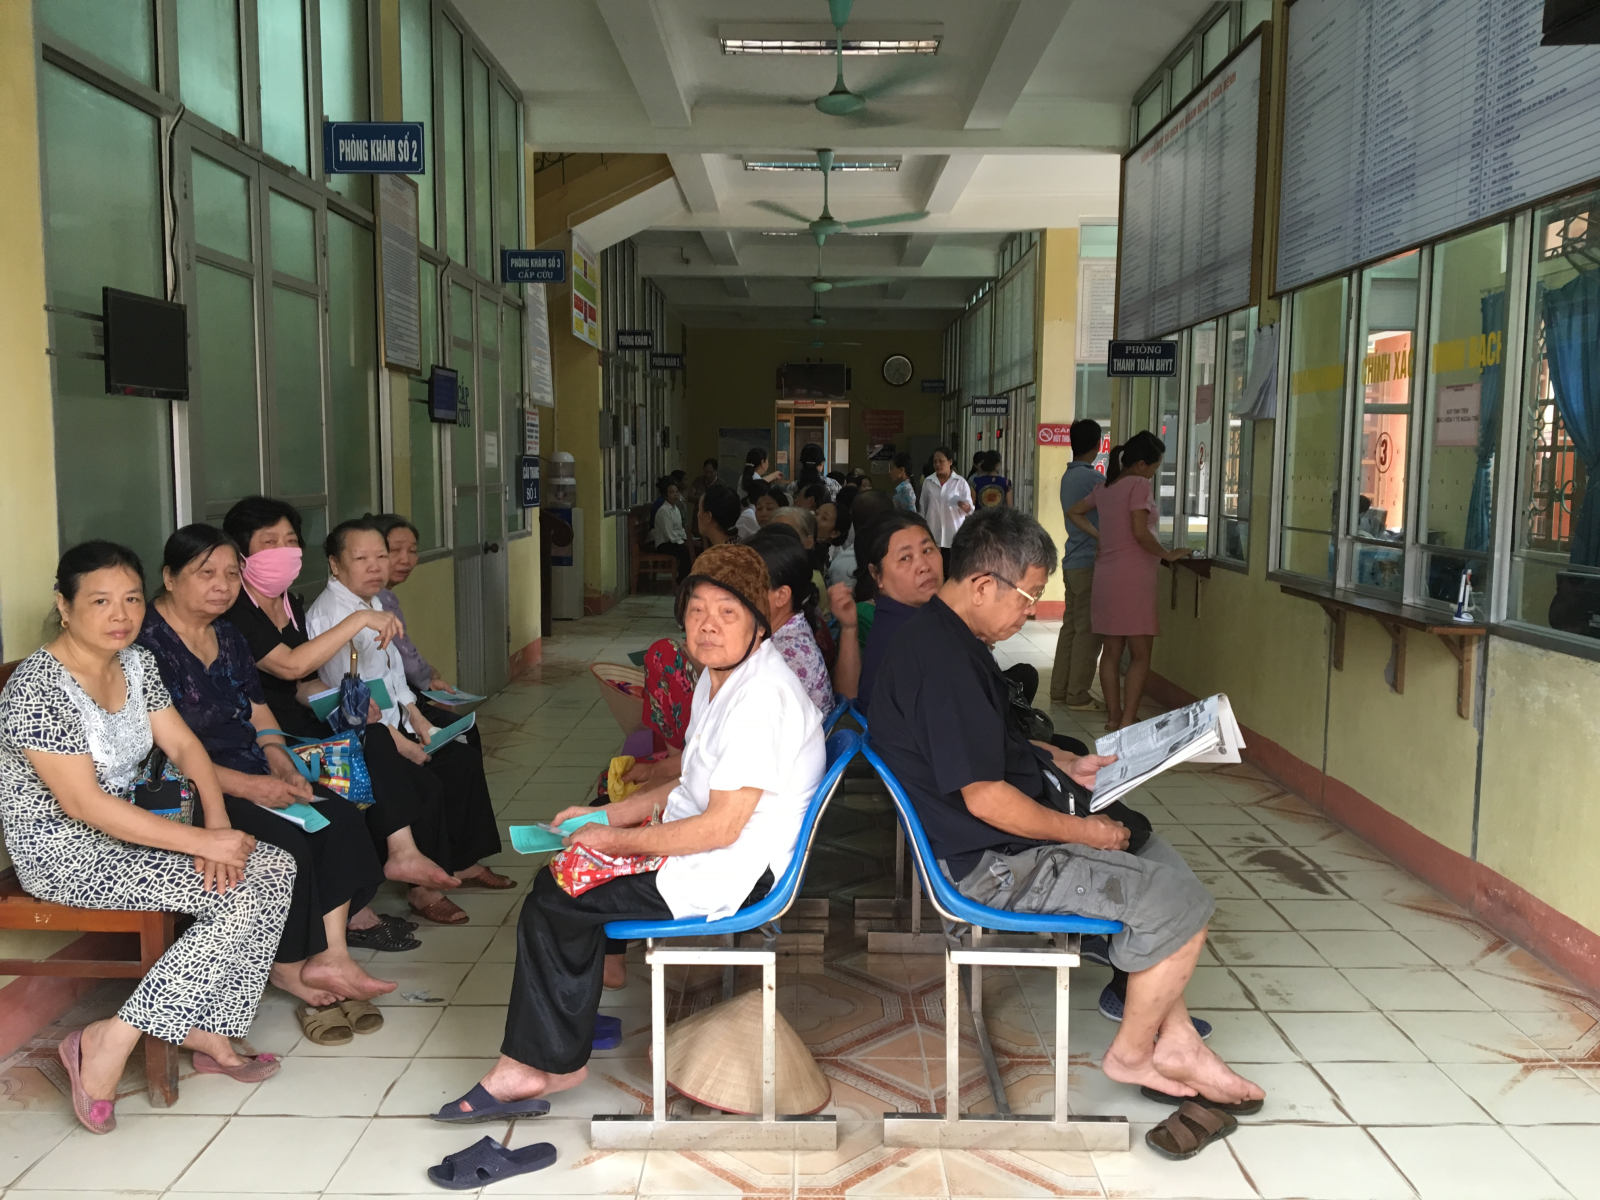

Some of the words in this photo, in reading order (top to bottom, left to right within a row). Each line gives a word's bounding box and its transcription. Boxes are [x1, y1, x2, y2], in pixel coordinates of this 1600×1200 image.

[339, 133, 369, 162] PHÒNG
[370, 134, 396, 162] KHÁM
[397, 131, 410, 162] SỐ
[411, 140, 418, 162] 2
[510, 256, 529, 268] PHÒNG
[530, 256, 547, 268] KHÁM
[548, 255, 556, 268] SỐ
[556, 258, 561, 268] 3
[518, 268, 535, 279] CẤP
[536, 270, 554, 279] CỨU
[1125, 343, 1162, 354] PHÒNG
[1113, 358, 1136, 372] THANH
[1137, 355, 1154, 372] TOÁN
[1155, 358, 1173, 372] BHYT
[1362, 349, 1391, 386] CHÍNH
[1393, 343, 1414, 381] XÁC
[1199, 446, 1204, 465] 2
[1380, 439, 1388, 466] 3
[526, 481, 533, 500] SỐ
[533, 487, 537, 499] 1
